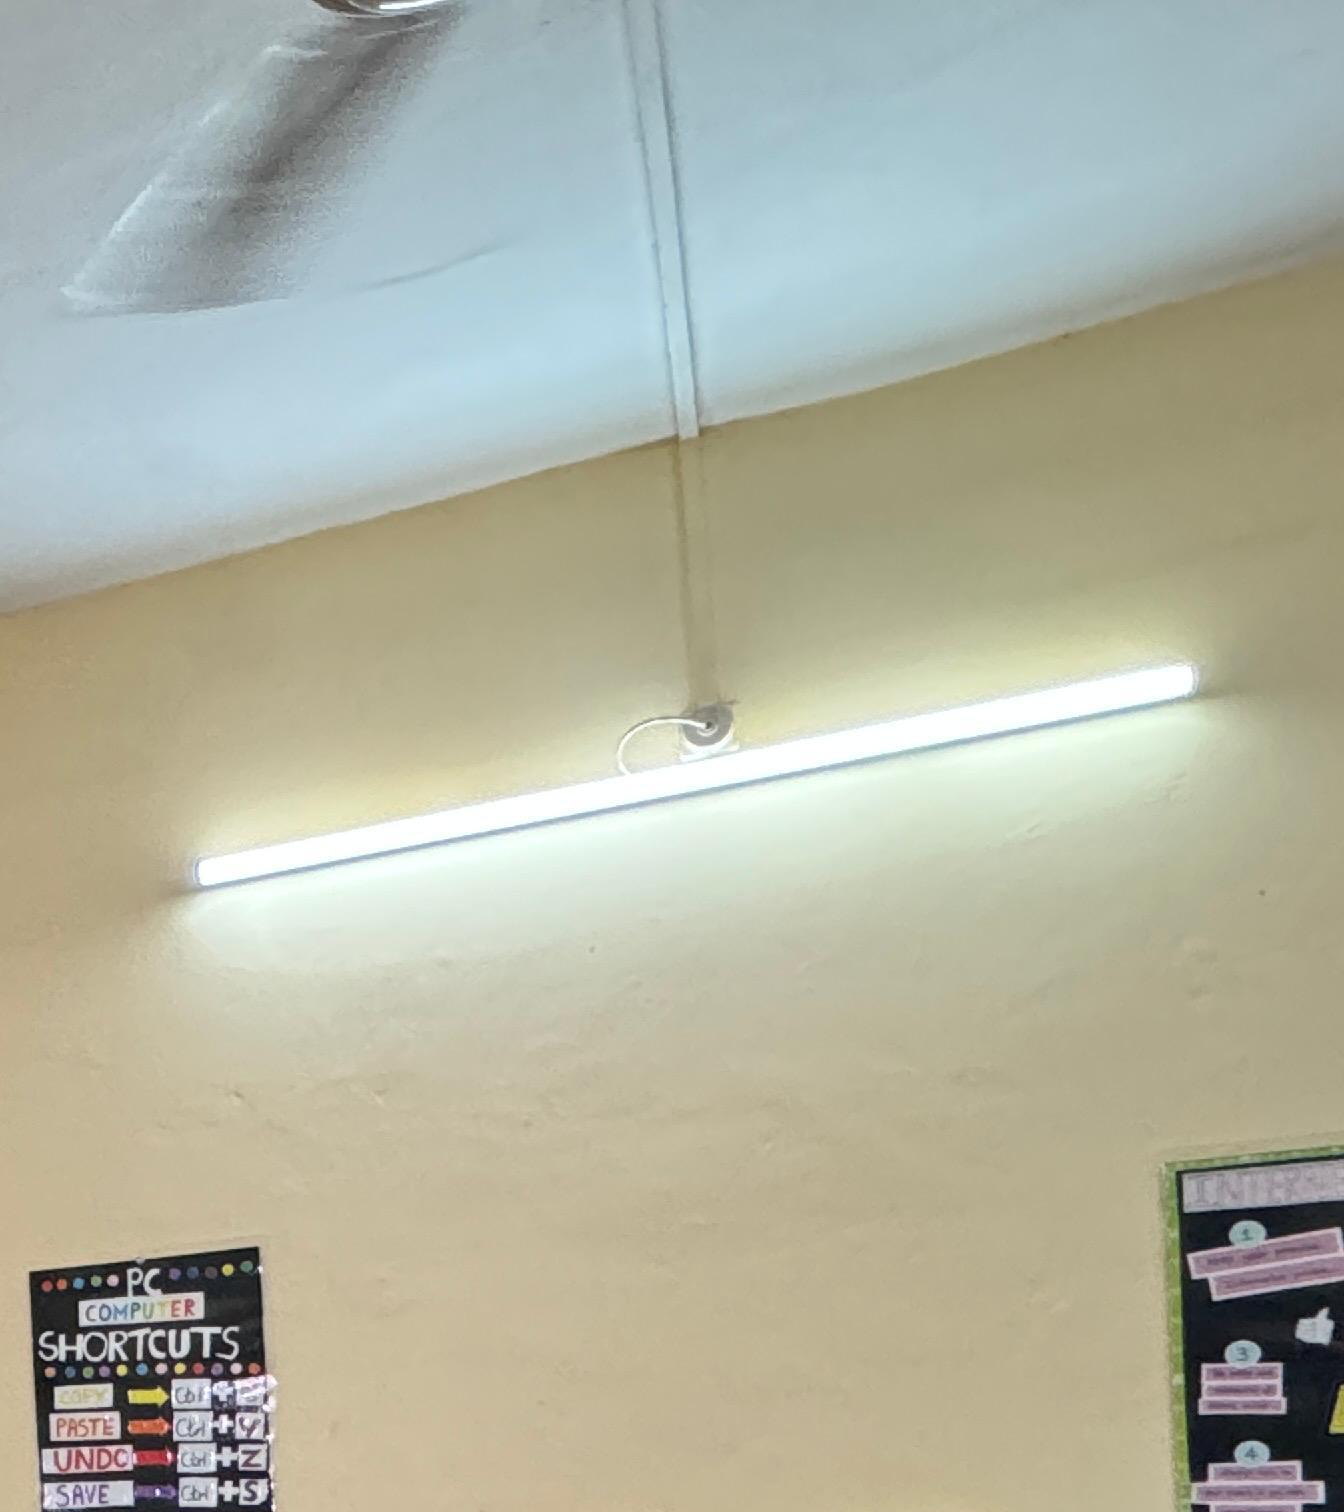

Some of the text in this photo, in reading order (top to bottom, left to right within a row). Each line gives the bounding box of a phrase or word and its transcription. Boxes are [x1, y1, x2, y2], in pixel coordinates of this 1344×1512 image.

[126, 1267, 162, 1297] PC
[85, 1298, 195, 1322] COMPUTER
[38, 1326, 240, 1362] SHORTCUTS
[1236, 1347, 1248, 1361] 3
[58, 1388, 109, 1404] COPY
[56, 1417, 115, 1438] PASTE
[241, 1449, 262, 1467] Z
[1244, 1447, 1258, 1460] 4
[56, 1484, 110, 1506] SAVE
[243, 1480, 258, 1501] S
